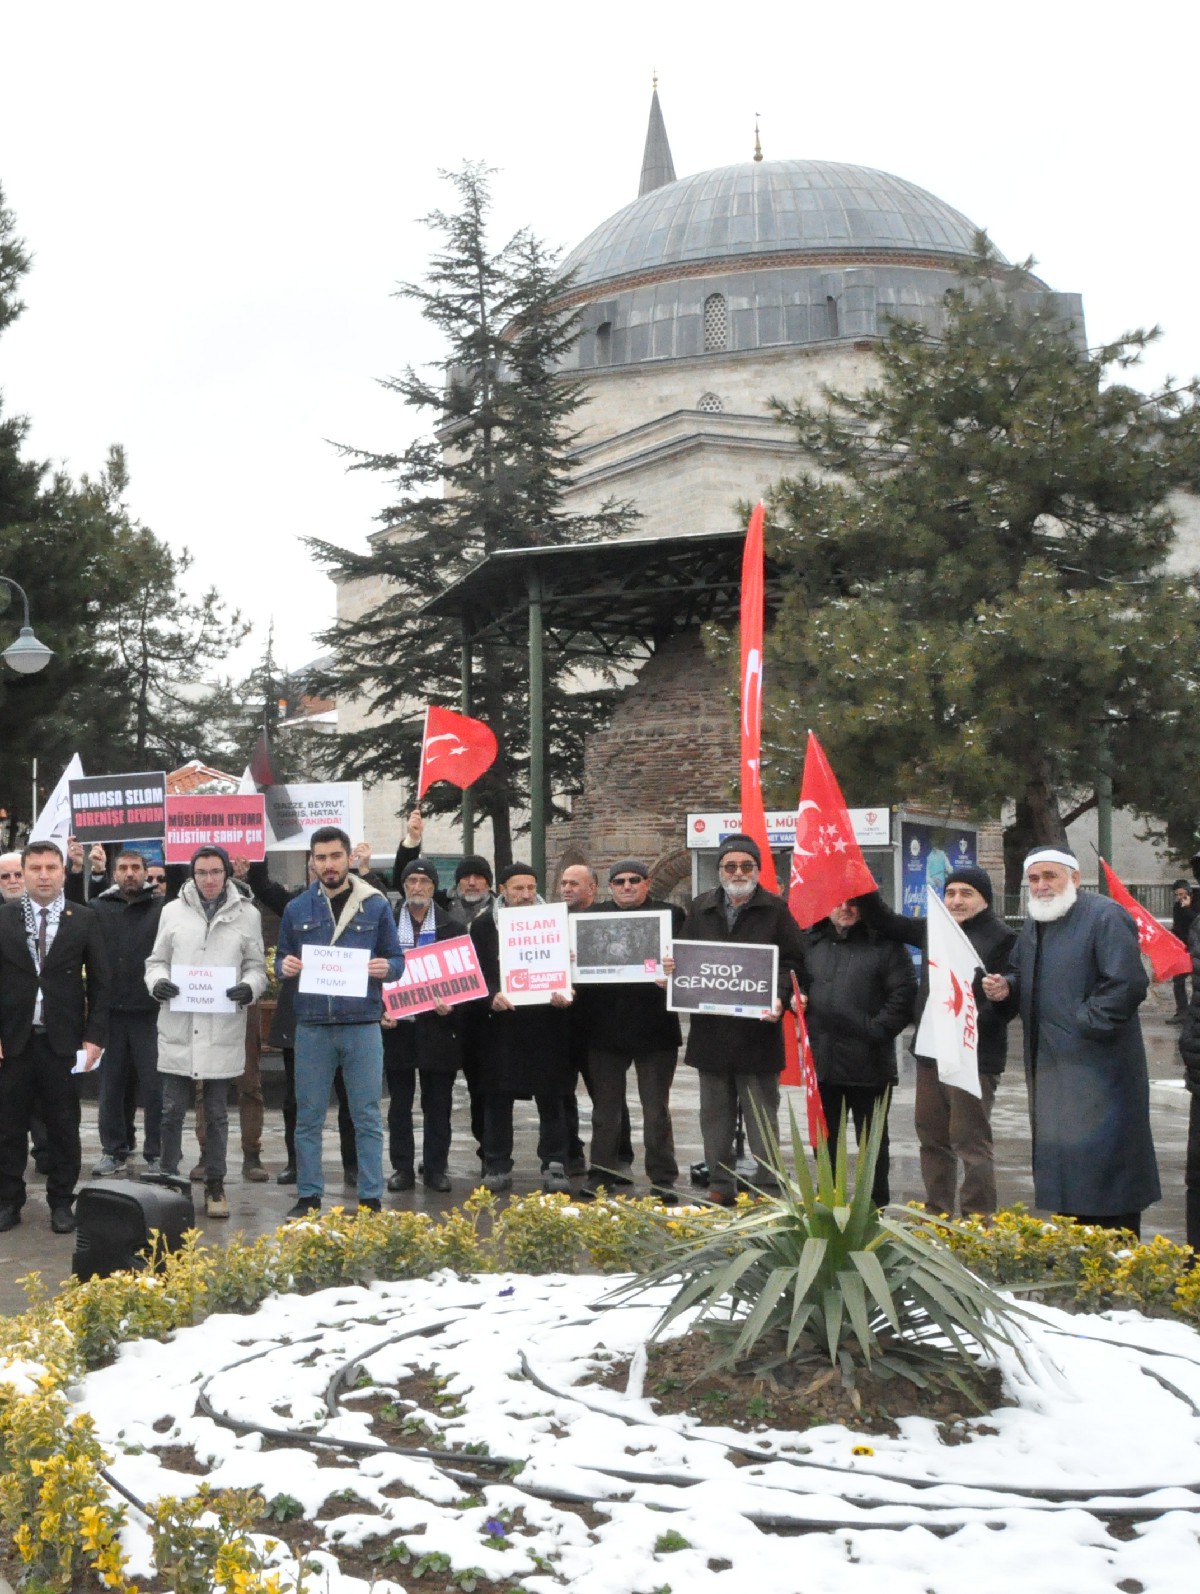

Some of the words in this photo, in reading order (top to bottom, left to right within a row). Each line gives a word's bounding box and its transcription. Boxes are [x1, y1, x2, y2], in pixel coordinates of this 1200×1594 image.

[72, 790, 123, 809] HAMASA
[125, 787, 163, 805] SELAM
[127, 807, 164, 823] DEVAM
[227, 813, 262, 826] UYUMA
[213, 827, 244, 843] SAHİP
[246, 829, 263, 845] ÇIK
[511, 919, 556, 932] İSLAM
[519, 948, 551, 963] İÇİN
[321, 964, 344, 972] FOOL
[382, 954, 443, 990] ANA
[443, 945, 475, 975] NE
[700, 963, 743, 978] STOP
[316, 978, 346, 986] TRUMP
[674, 976, 768, 993] GENOCIDE
[186, 996, 215, 1004] TRUMP
